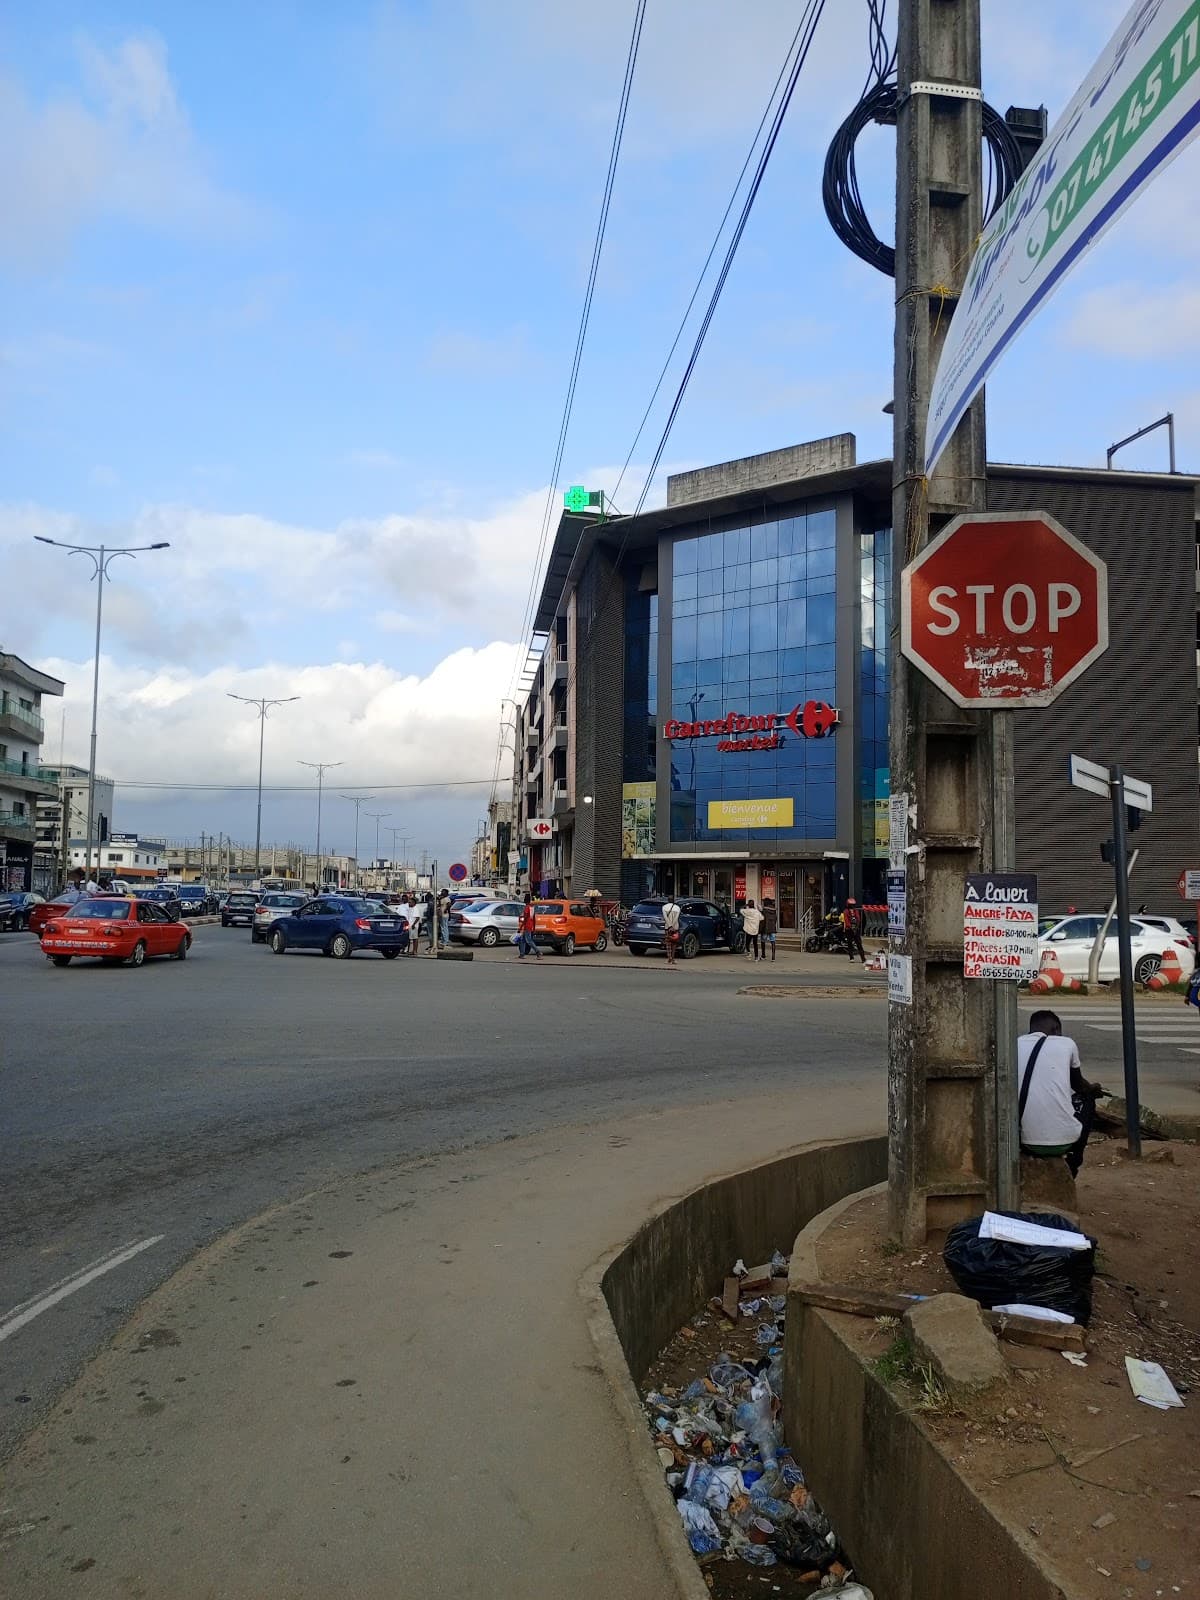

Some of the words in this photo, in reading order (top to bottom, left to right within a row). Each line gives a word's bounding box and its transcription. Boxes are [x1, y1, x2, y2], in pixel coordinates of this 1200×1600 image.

[1051, 164, 1082, 232] 07
[1085, 117, 1120, 186] 47
[1122, 61, 1163, 138] 45
[927, 583, 1081, 636] STOP
[665, 712, 778, 739] Carrefour
[717, 734, 778, 752] market
[722, 802, 778, 815] bienvenue
[965, 882, 980, 900] À
[982, 882, 1028, 904] louer
[965, 953, 1021, 966] MAGASIN
